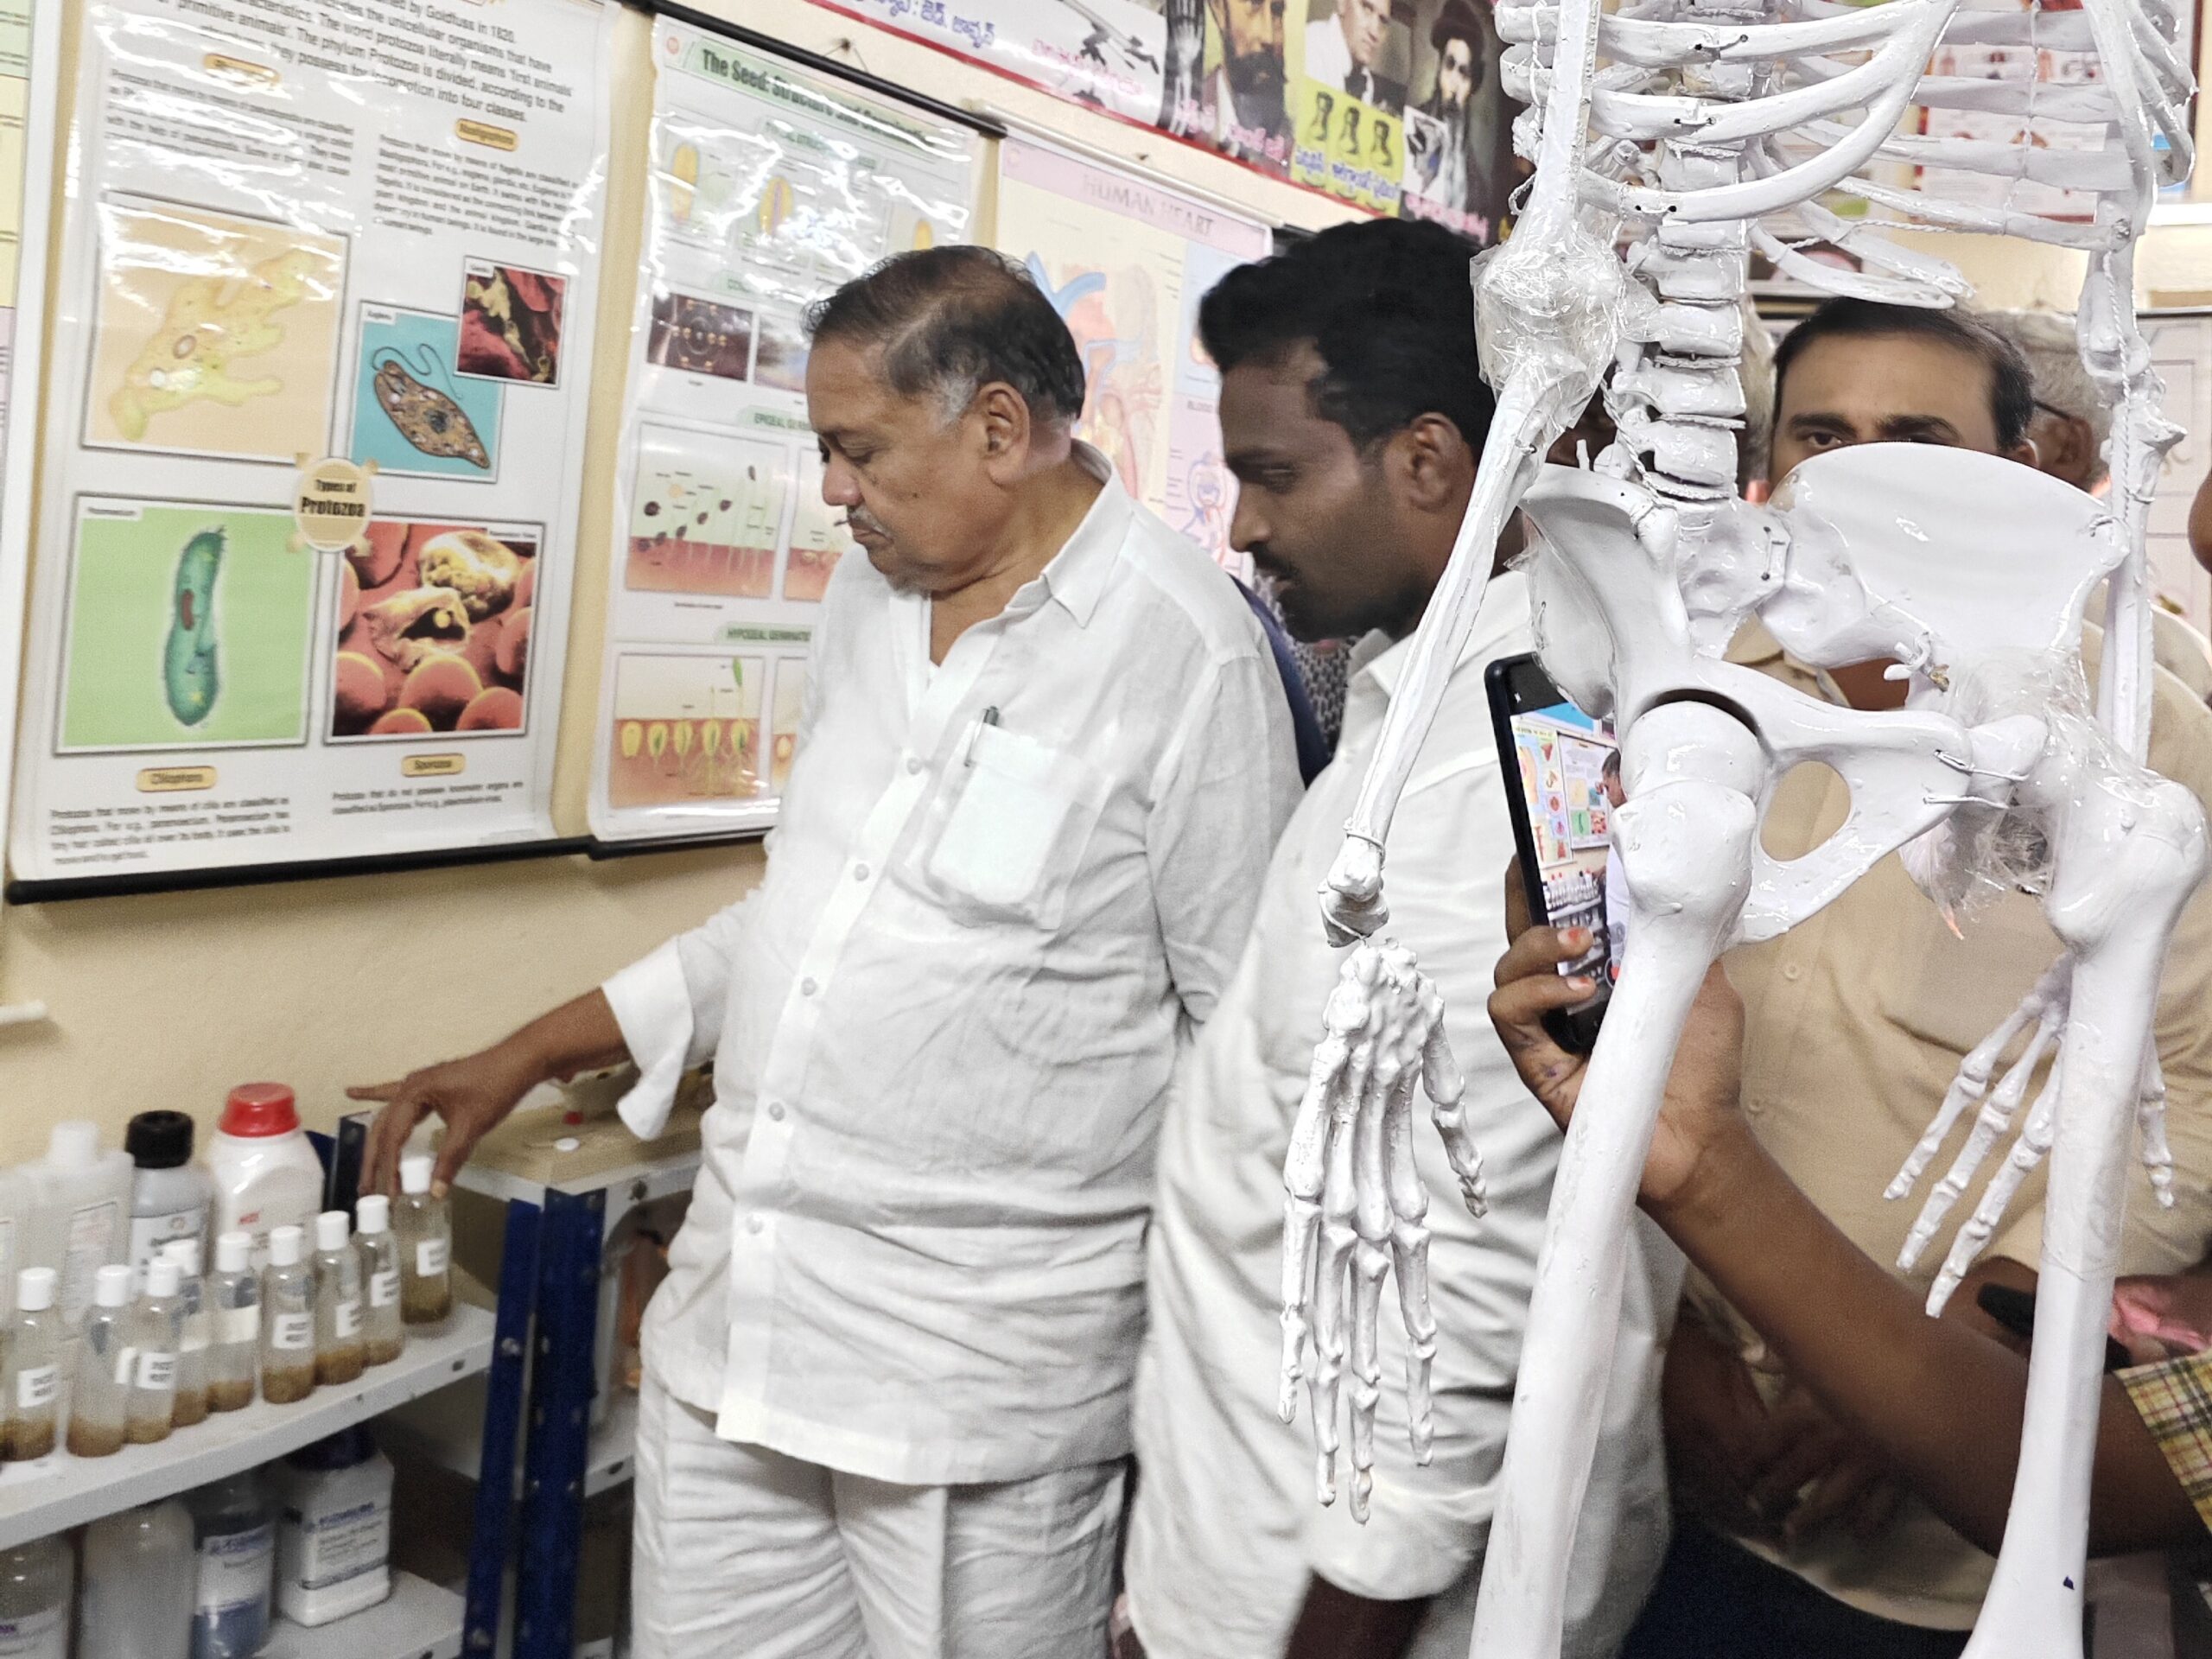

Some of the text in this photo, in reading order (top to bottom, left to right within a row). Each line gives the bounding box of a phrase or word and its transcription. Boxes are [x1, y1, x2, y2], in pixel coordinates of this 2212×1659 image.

[319, 11, 340, 31] The
[703, 48, 728, 77] The
[732, 60, 769, 91] Seed:
[301, 496, 366, 518] Protozoa
